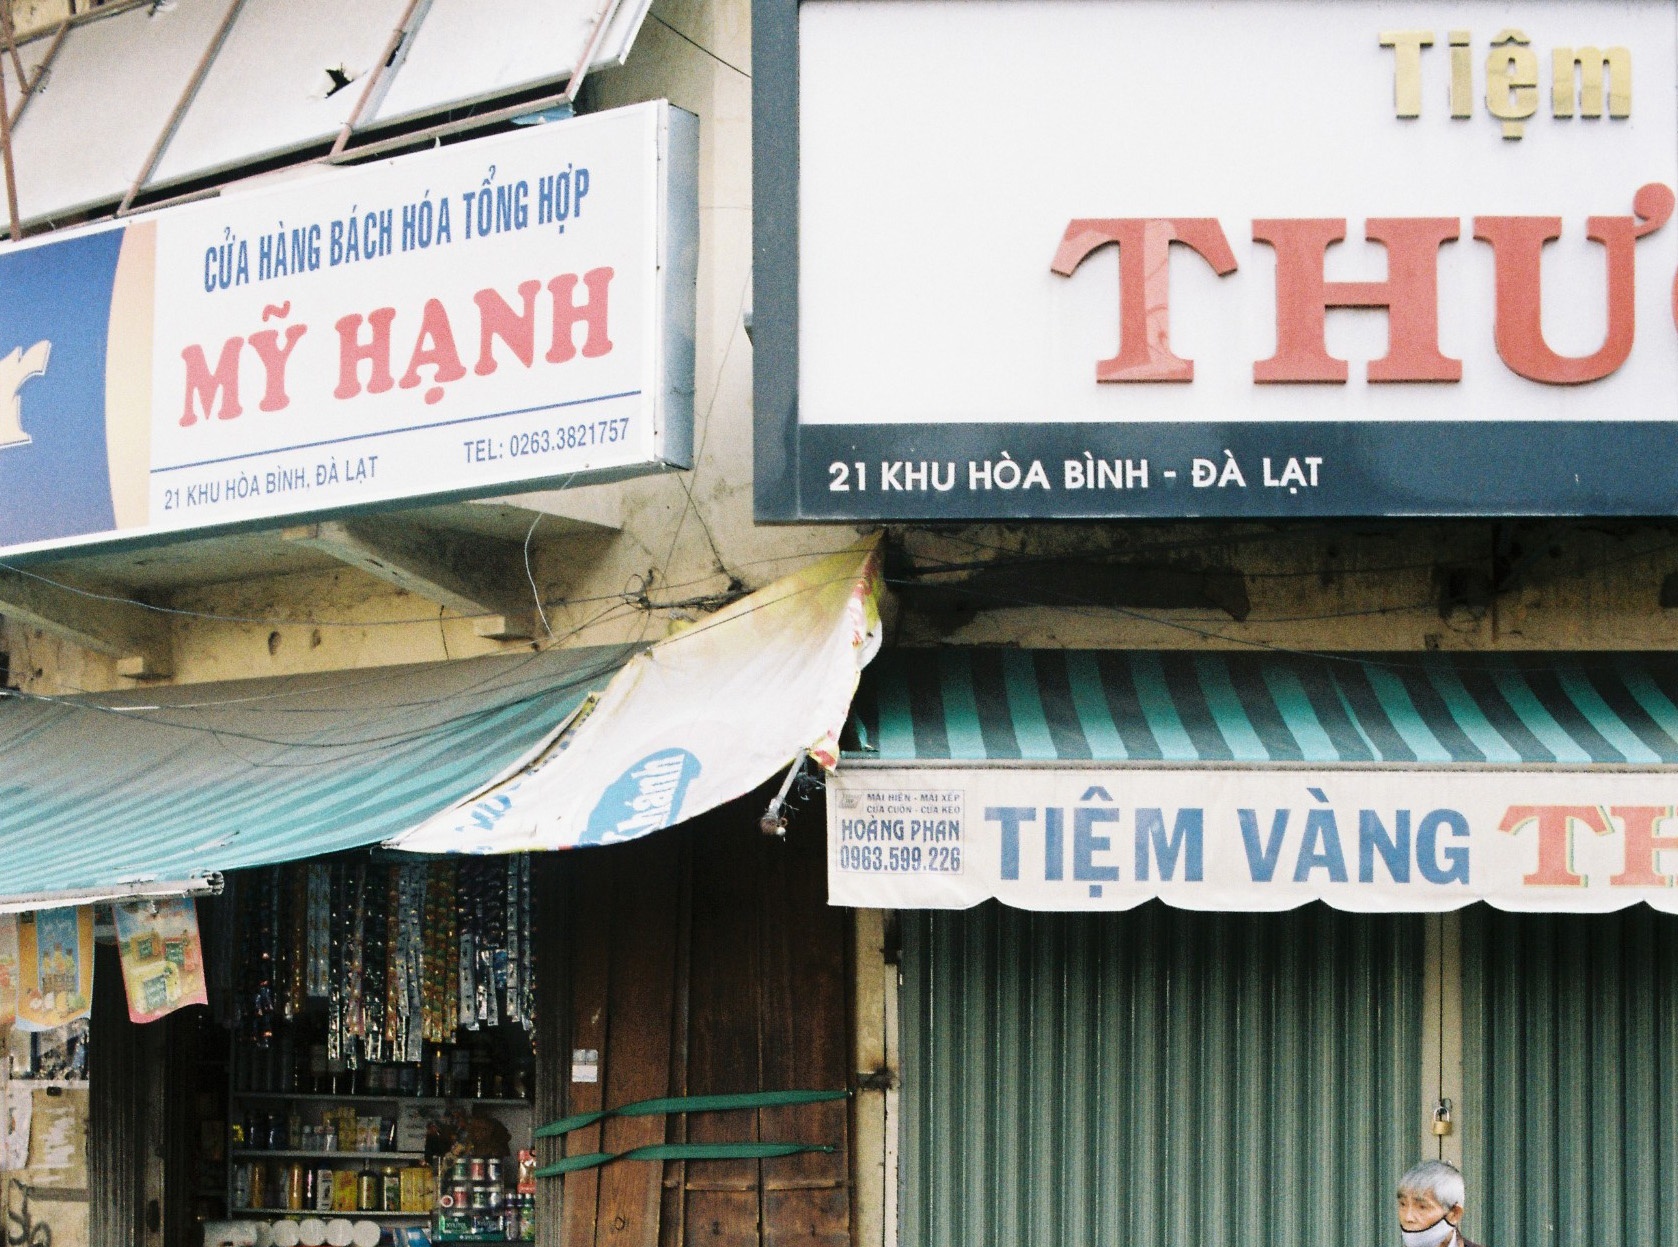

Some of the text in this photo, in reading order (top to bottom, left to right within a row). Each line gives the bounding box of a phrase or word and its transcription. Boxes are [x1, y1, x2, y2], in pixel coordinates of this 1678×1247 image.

[1382, 30, 1632, 139] Tiệm
[204, 163, 590, 292] CỬA HÀNG BÁCH HÓA TỔNG HỢP
[1050, 182, 1678, 387] THƯ
[179, 299, 308, 428] MỸ
[333, 266, 615, 406] HẠNH
[165, 488, 180, 509] 21
[187, 481, 220, 506] KHU
[226, 471, 260, 500] HÒA
[316, 456, 339, 486] ĐÀ
[346, 455, 379, 484] LẠT
[464, 417, 630, 463] TEL: 0263.3821757
[829, 461, 866, 492] 21
[881, 461, 956, 492] KHU
[968, 450, 1051, 490] HÒA
[1064, 450, 1149, 489] BÌNH
[1191, 449, 1247, 488] ĐÀ
[1262, 457, 1323, 494] LẠT
[840, 845, 960, 871] 0963.599.226
[984, 785, 1205, 898] TIỆM
[1238, 786, 1470, 885] VÀNG
